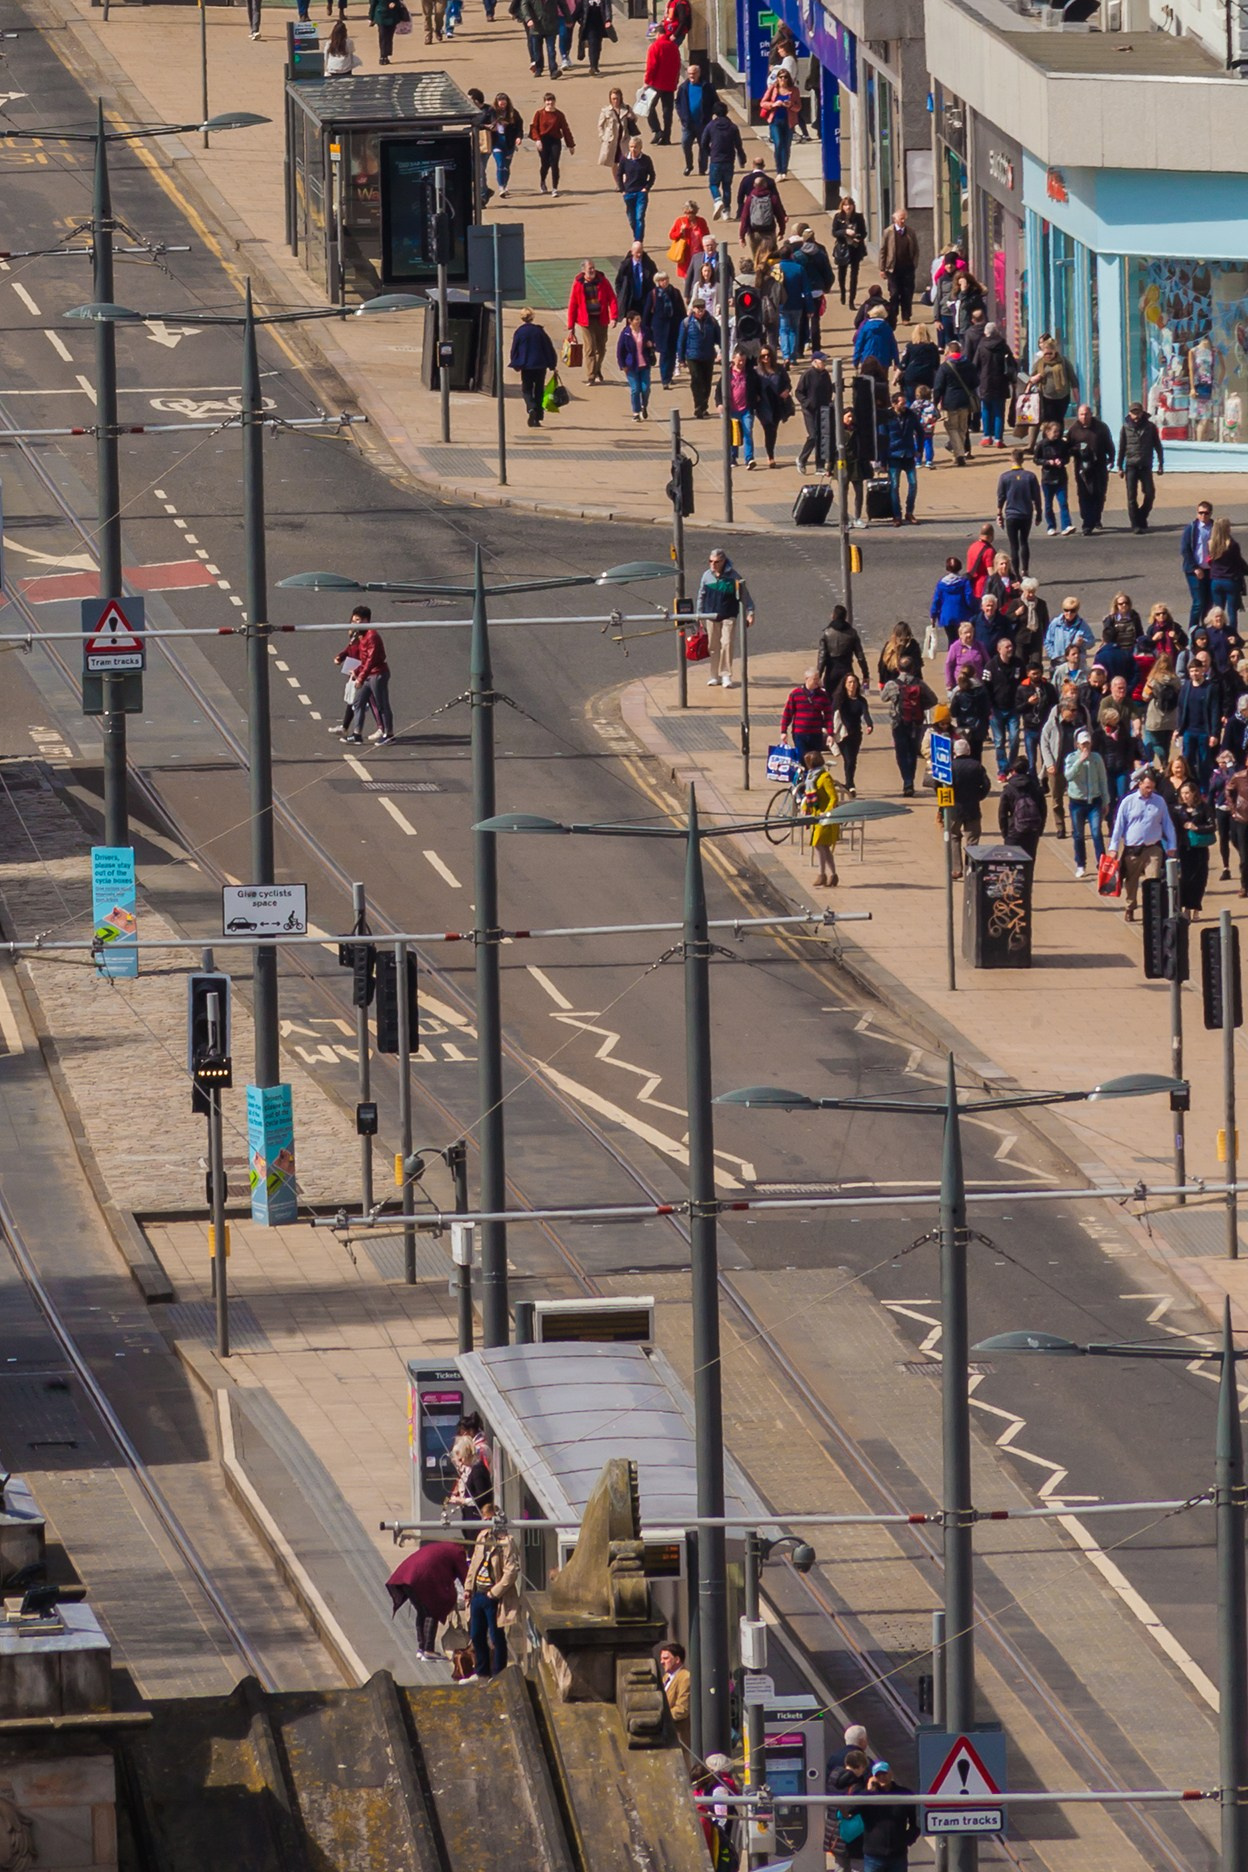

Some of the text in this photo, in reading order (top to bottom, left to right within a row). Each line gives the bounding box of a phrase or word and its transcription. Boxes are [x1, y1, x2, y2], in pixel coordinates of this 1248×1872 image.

[90, 657, 140, 666] Tram tracks
[94, 861, 131, 870] please stay
[94, 877, 133, 885] cycle boxes
[237, 888, 292, 899] Give cyclists
[252, 900, 277, 908] space
[434, 1372, 462, 1380] Tickets
[776, 1712, 804, 1720] Tickets
[930, 1815, 998, 1827] Tram tracks
